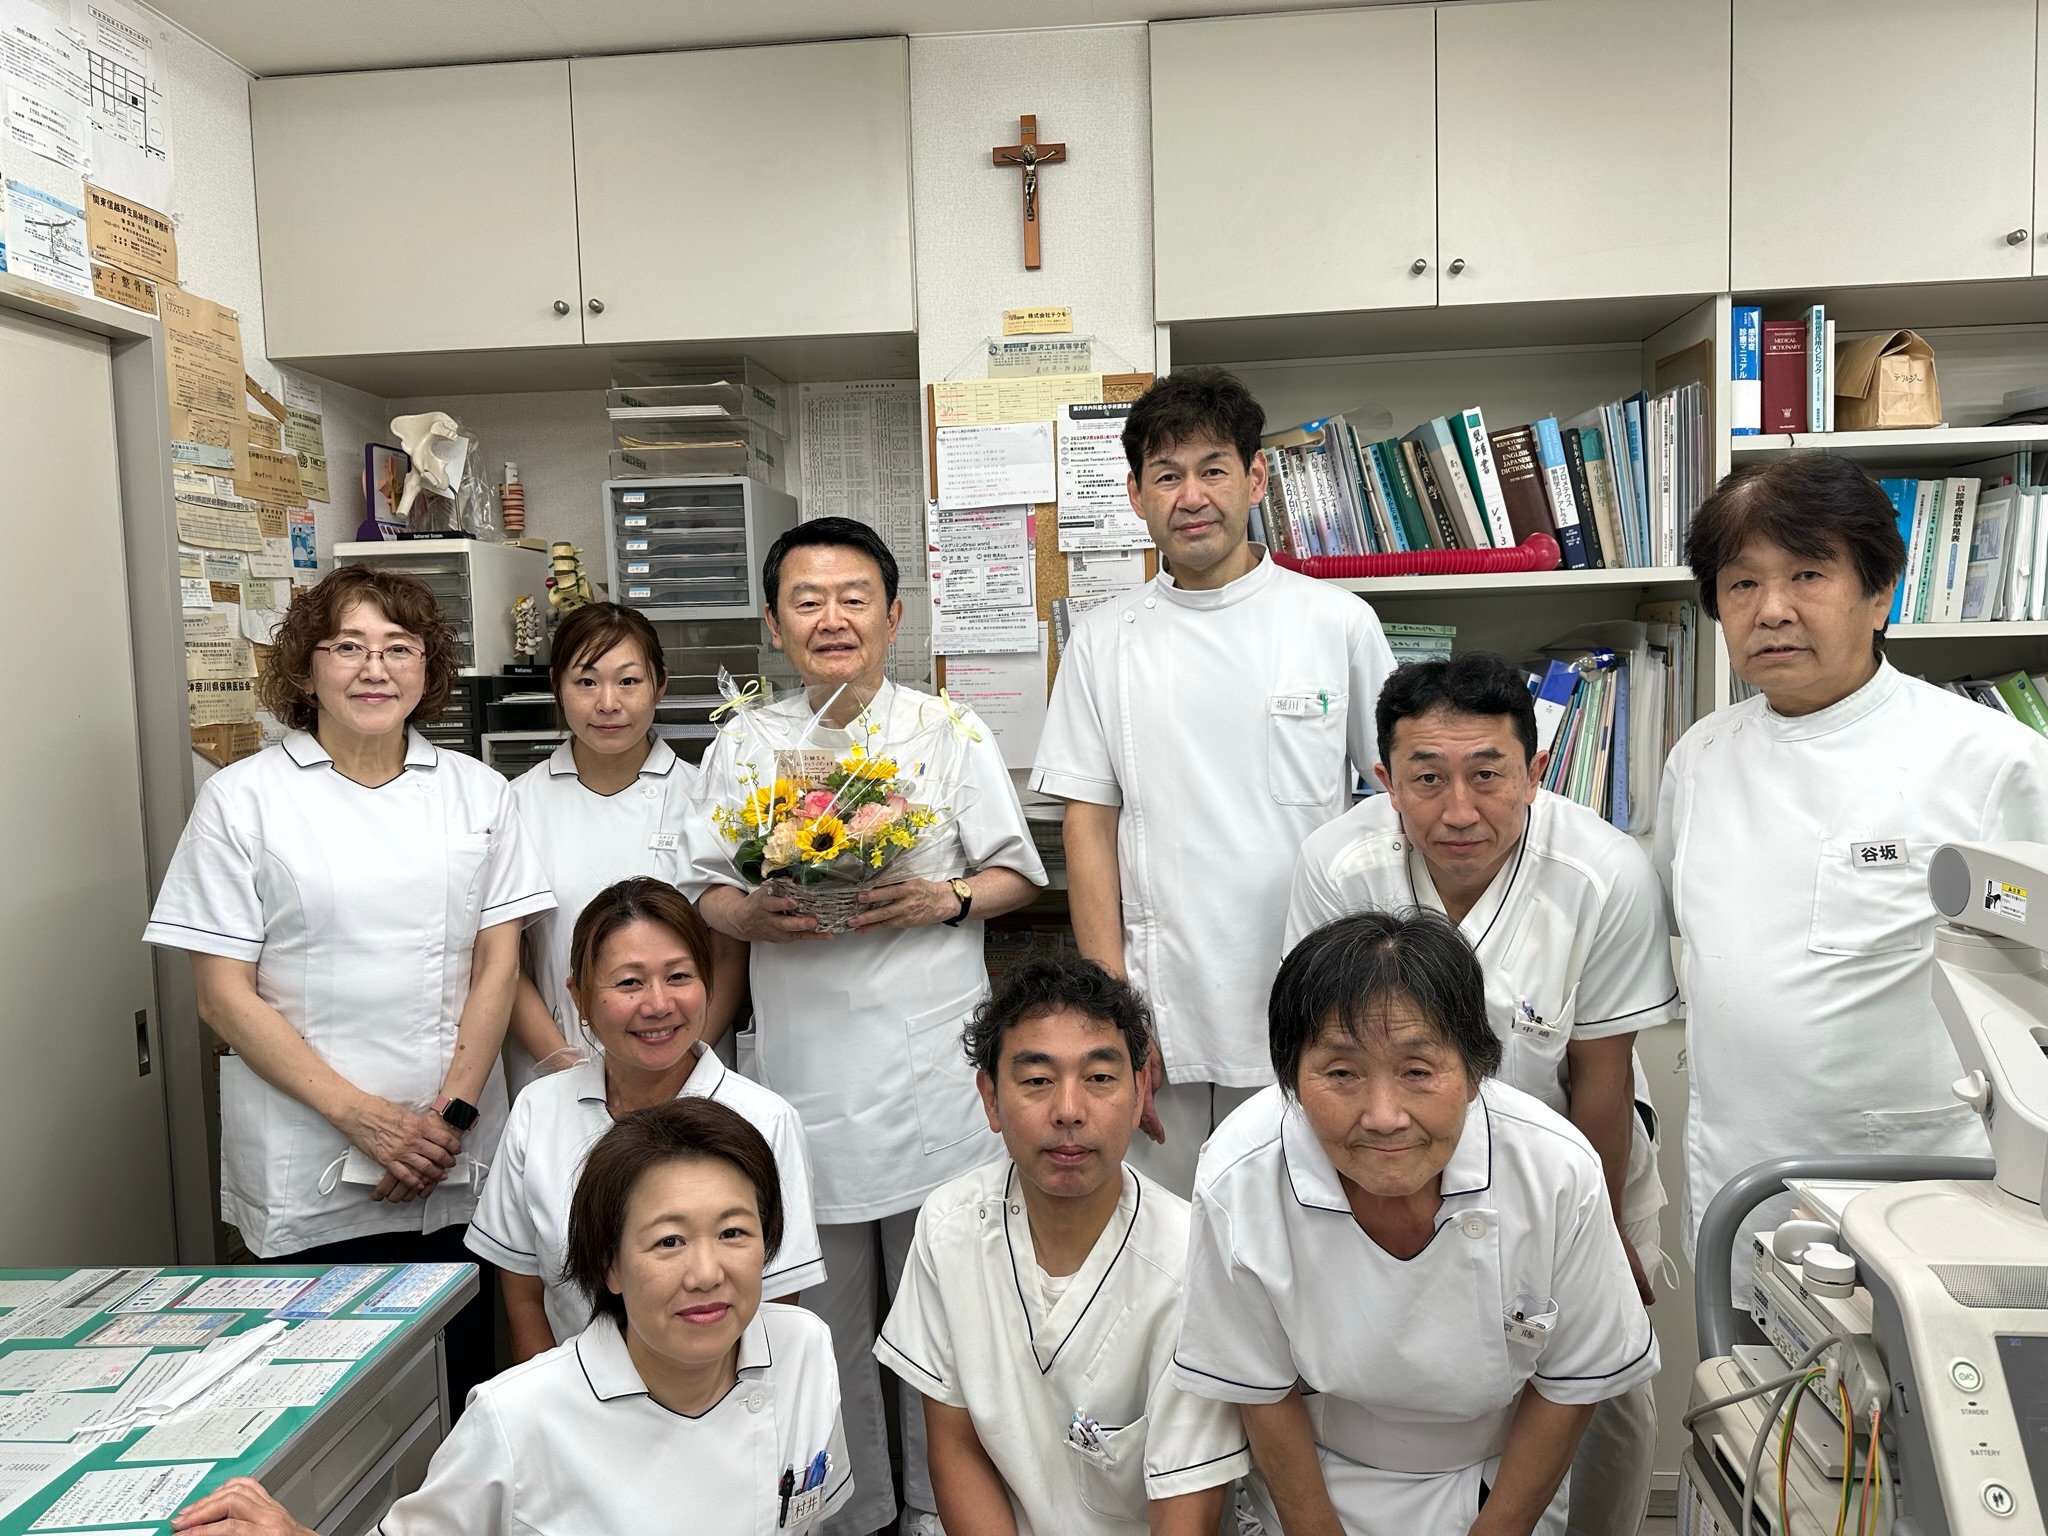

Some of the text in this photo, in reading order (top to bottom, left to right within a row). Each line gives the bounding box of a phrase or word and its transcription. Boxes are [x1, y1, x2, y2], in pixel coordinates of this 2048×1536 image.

[1030, 342, 1087, 351] 藤沢工科高等学校
[1748, 328, 1756, 351] 感染症
[1739, 328, 1747, 379] 診療マニュアル
[1472, 429, 1490, 475] 見積書
[1508, 444, 1522, 452] NEW
[1501, 463, 1537, 475] DICTIONARY
[1503, 456, 1533, 468] JAPANESE
[1559, 467, 1574, 507] プロメテウス
[1592, 463, 1608, 508] 小児科学
[1558, 500, 1569, 526] アトラス
[1951, 492, 1966, 543] 診療点数早見表
[1275, 699, 1299, 711] 堀川
[1861, 844, 1898, 863] 谷坂
[795, 1494, 818, 1519] 村井
